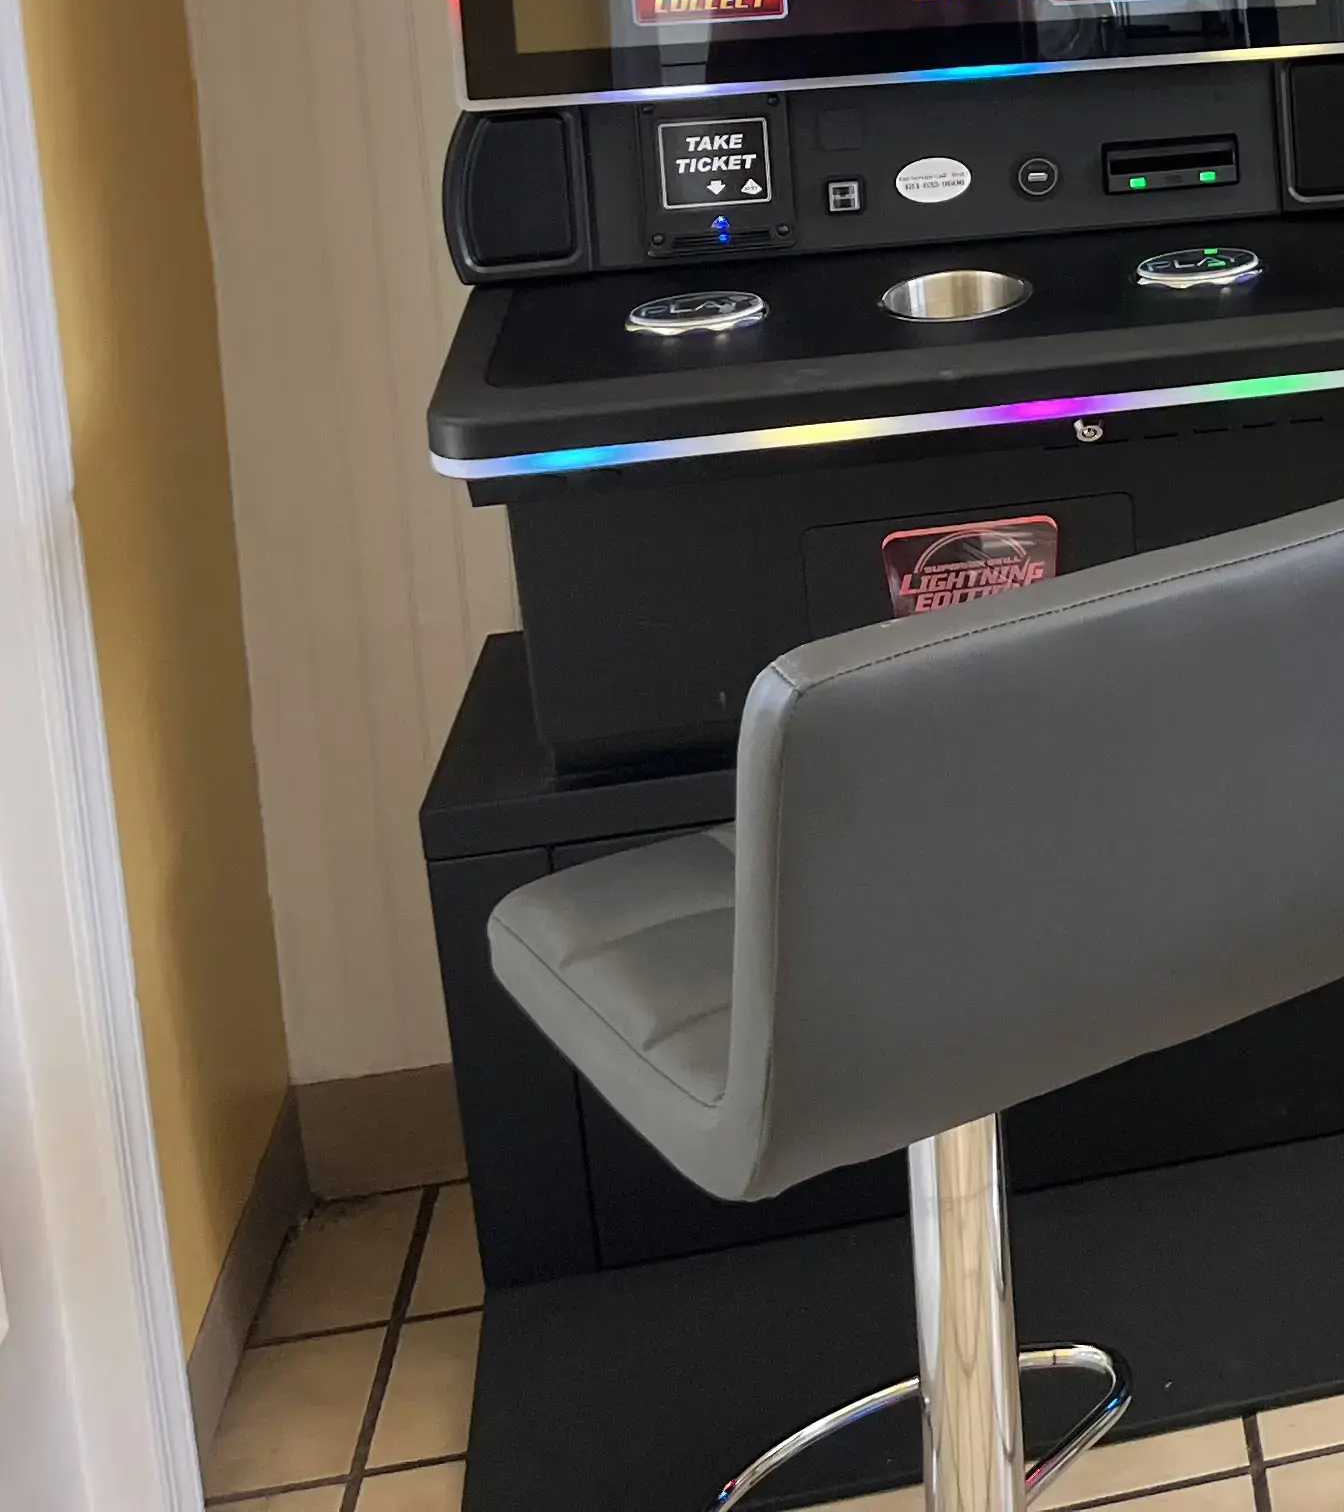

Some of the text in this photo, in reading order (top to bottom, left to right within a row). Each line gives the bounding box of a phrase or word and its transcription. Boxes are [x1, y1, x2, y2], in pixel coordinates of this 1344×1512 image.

[685, 134, 743, 152] TAKE
[676, 154, 756, 174] TICKET
[899, 557, 1045, 596] LIGHTNING
